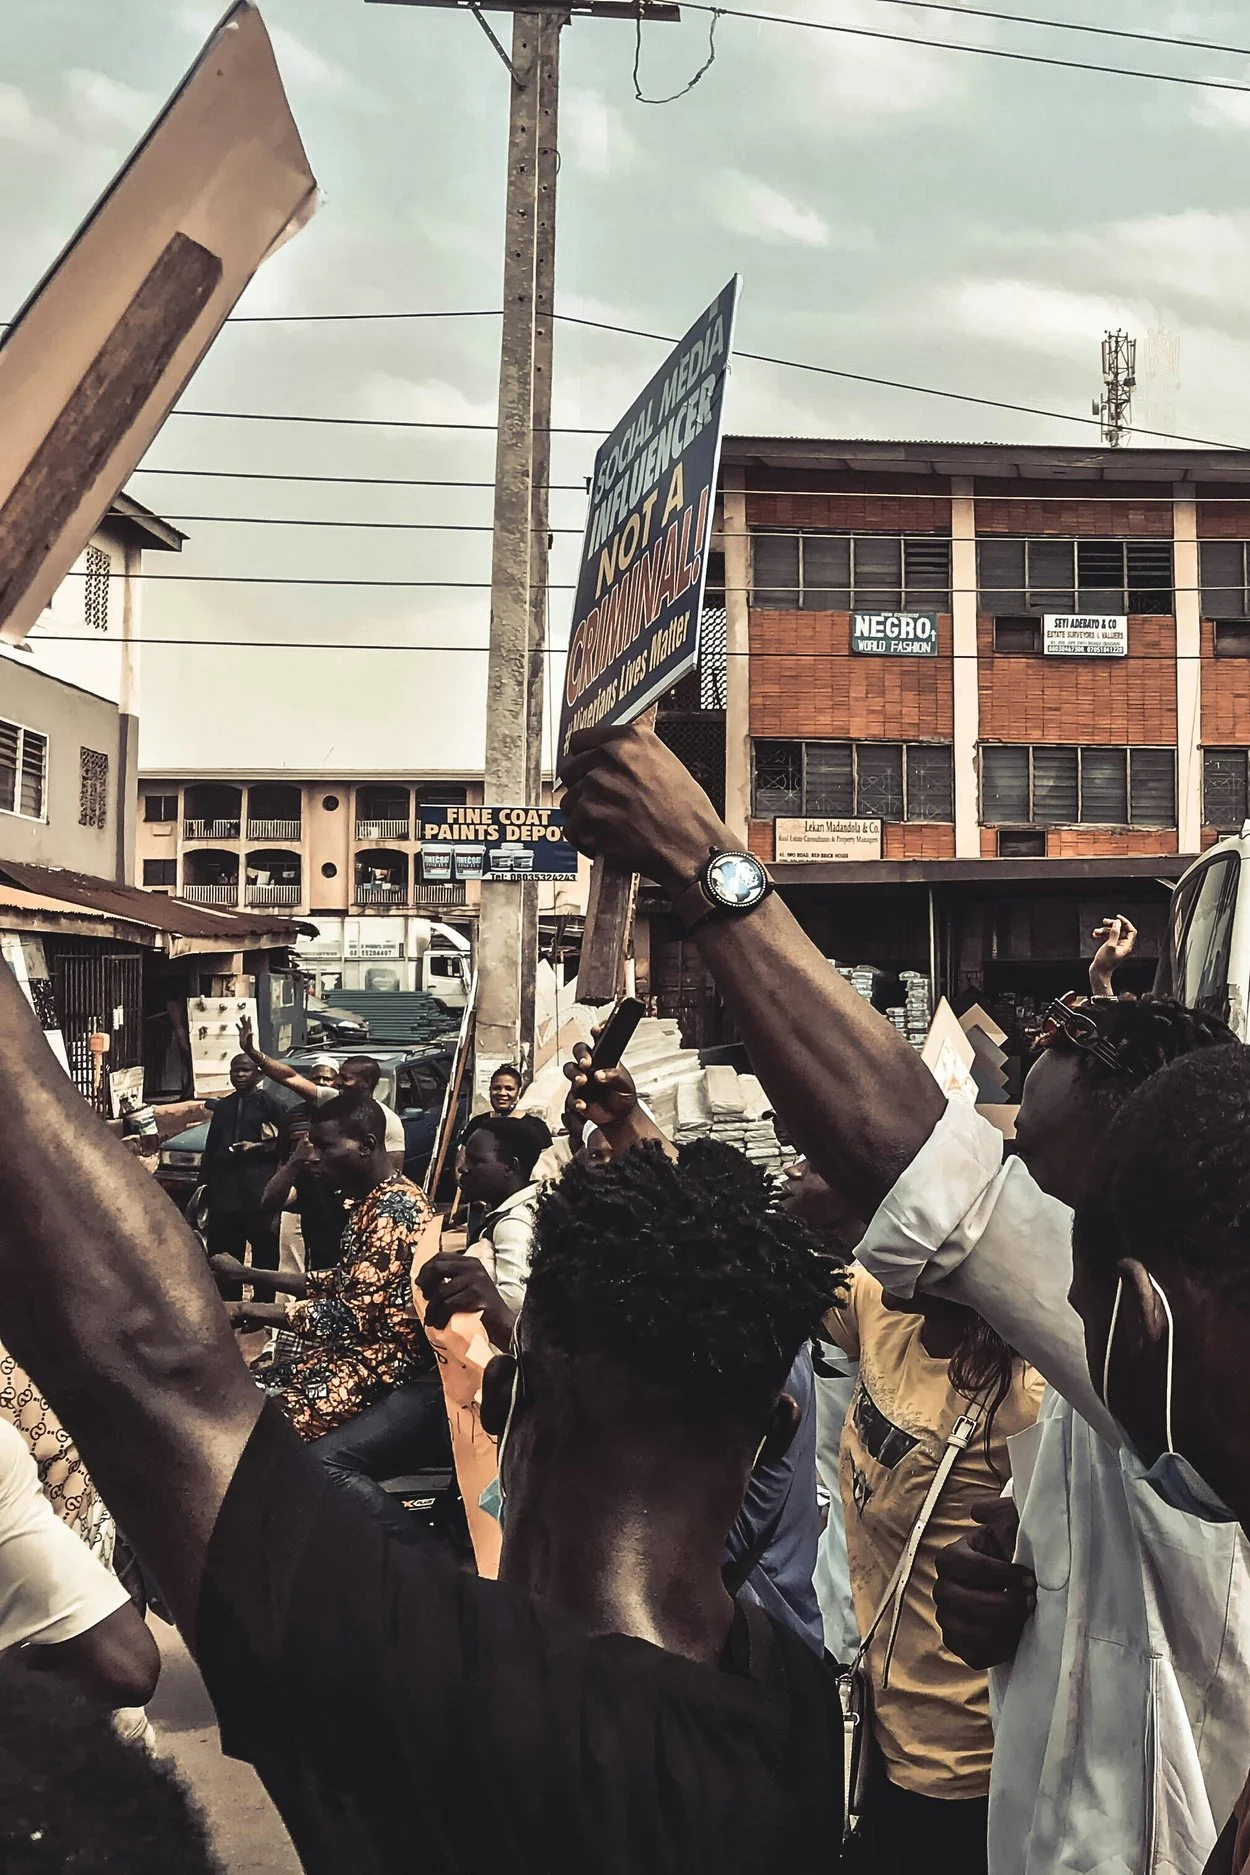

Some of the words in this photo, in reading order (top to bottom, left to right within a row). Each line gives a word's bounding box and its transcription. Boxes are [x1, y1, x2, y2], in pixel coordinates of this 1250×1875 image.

[594, 399, 654, 504] SOCIAL
[658, 313, 724, 425] MEDIA
[588, 372, 717, 560] INFLUENCER
[594, 489, 658, 600] NOT
[661, 460, 684, 529] A
[566, 484, 710, 707] CRIMINAL!
[618, 649, 648, 701] Lives
[649, 609, 691, 672] Matter
[854, 615, 931, 639] NEGRO
[858, 640, 886, 652] WORLD
[890, 640, 931, 653] FASHION
[425, 824, 500, 841] PAINTS
[506, 825, 568, 842] DEPO
[447, 808, 492, 824] FINE
[499, 809, 551, 825] COAT
[805, 820, 824, 833] Lekan
[862, 822, 868, 833] &
